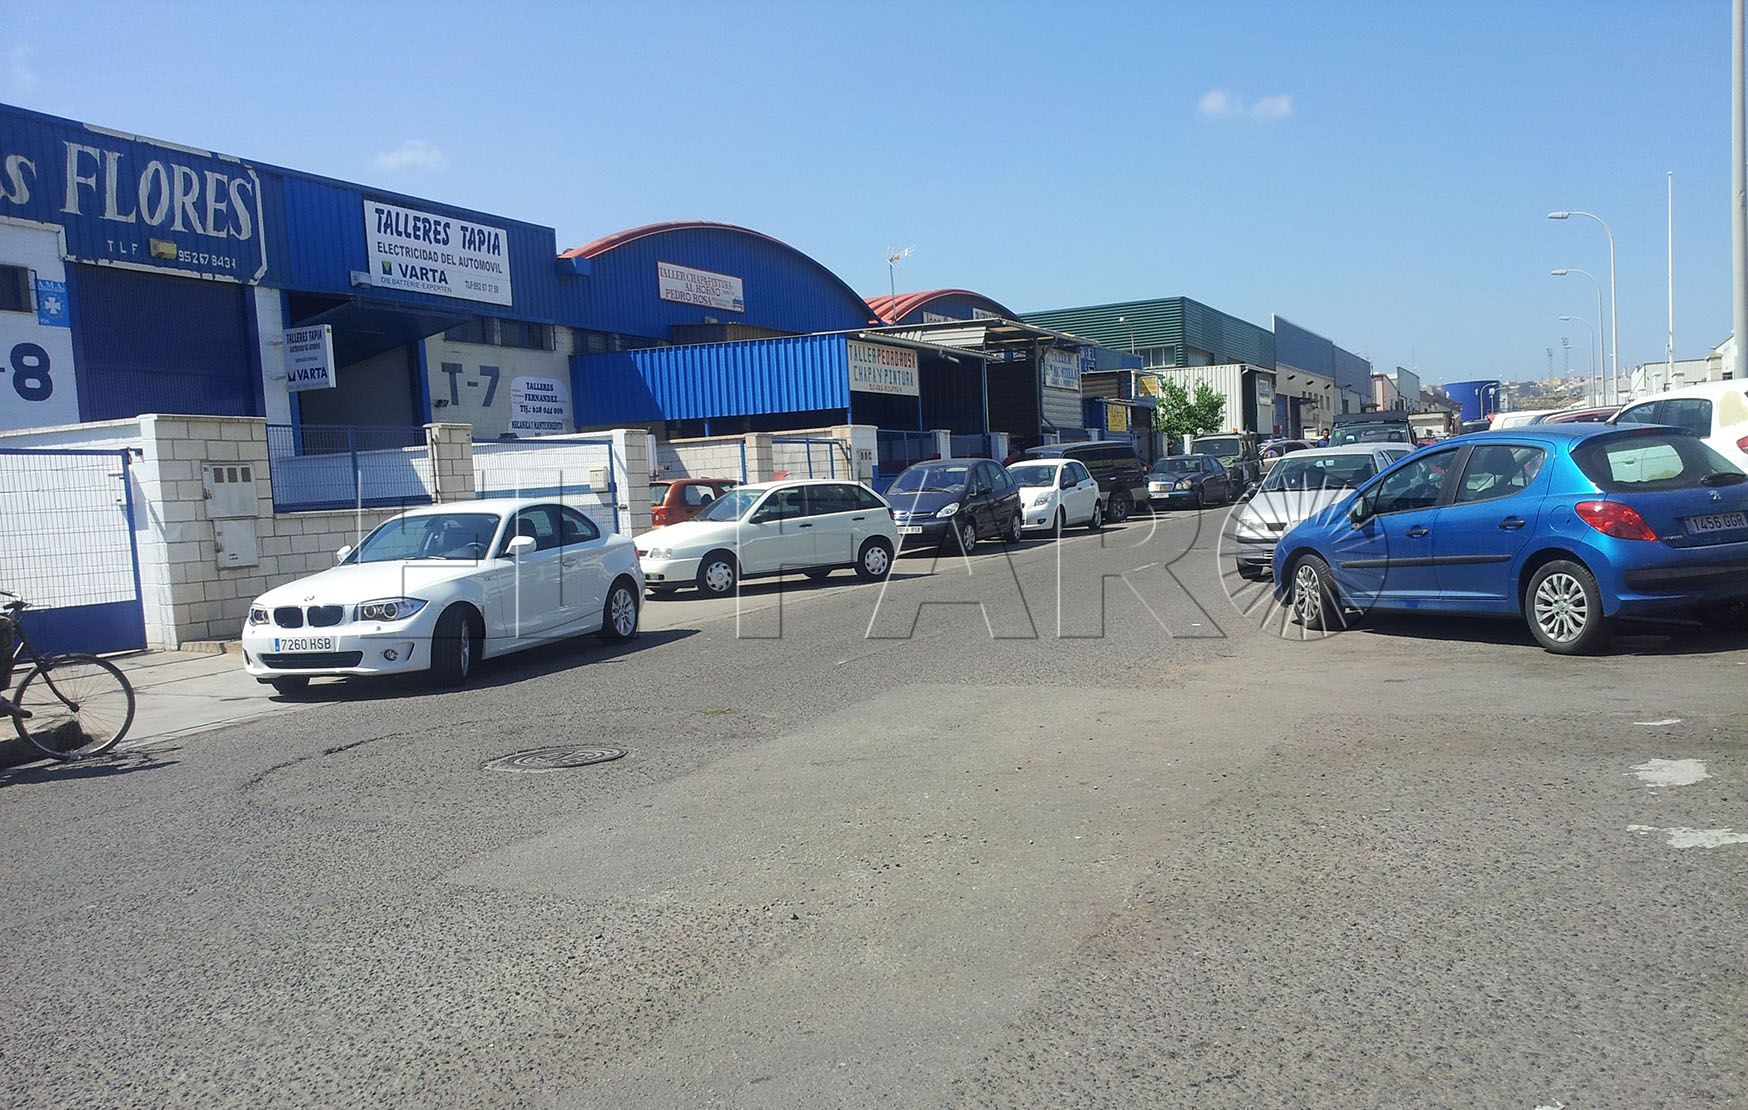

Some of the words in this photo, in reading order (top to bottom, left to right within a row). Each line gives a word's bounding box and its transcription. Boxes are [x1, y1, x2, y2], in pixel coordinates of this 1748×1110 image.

[59, 141, 253, 241] FLORES
[375, 208, 451, 246] TALLERES
[460, 226, 501, 256] TAPIA
[377, 241, 439, 263] ELECTRICIDAD
[441, 254, 456, 266] DEL
[458, 257, 502, 273] AUTOMOVIL
[399, 263, 448, 285] VARTA
[659, 267, 686, 281] TALLER
[665, 288, 692, 301] PEDRO
[693, 294, 713, 305] ROSA
[686, 282, 694, 292] AL
[696, 284, 721, 296] HORNO
[286, 331, 308, 344] TALLERES
[309, 329, 322, 341] TAPIA
[849, 345, 876, 364] TALLER
[0, 343, 53, 401] 8
[297, 366, 328, 381] VARTA
[441, 362, 500, 407] T-7
[526, 382, 554, 391] TALLERES
[524, 393, 558, 403] FERNANDEZ
[281, 639, 307, 651] 7260
[309, 638, 331, 650] HSB
